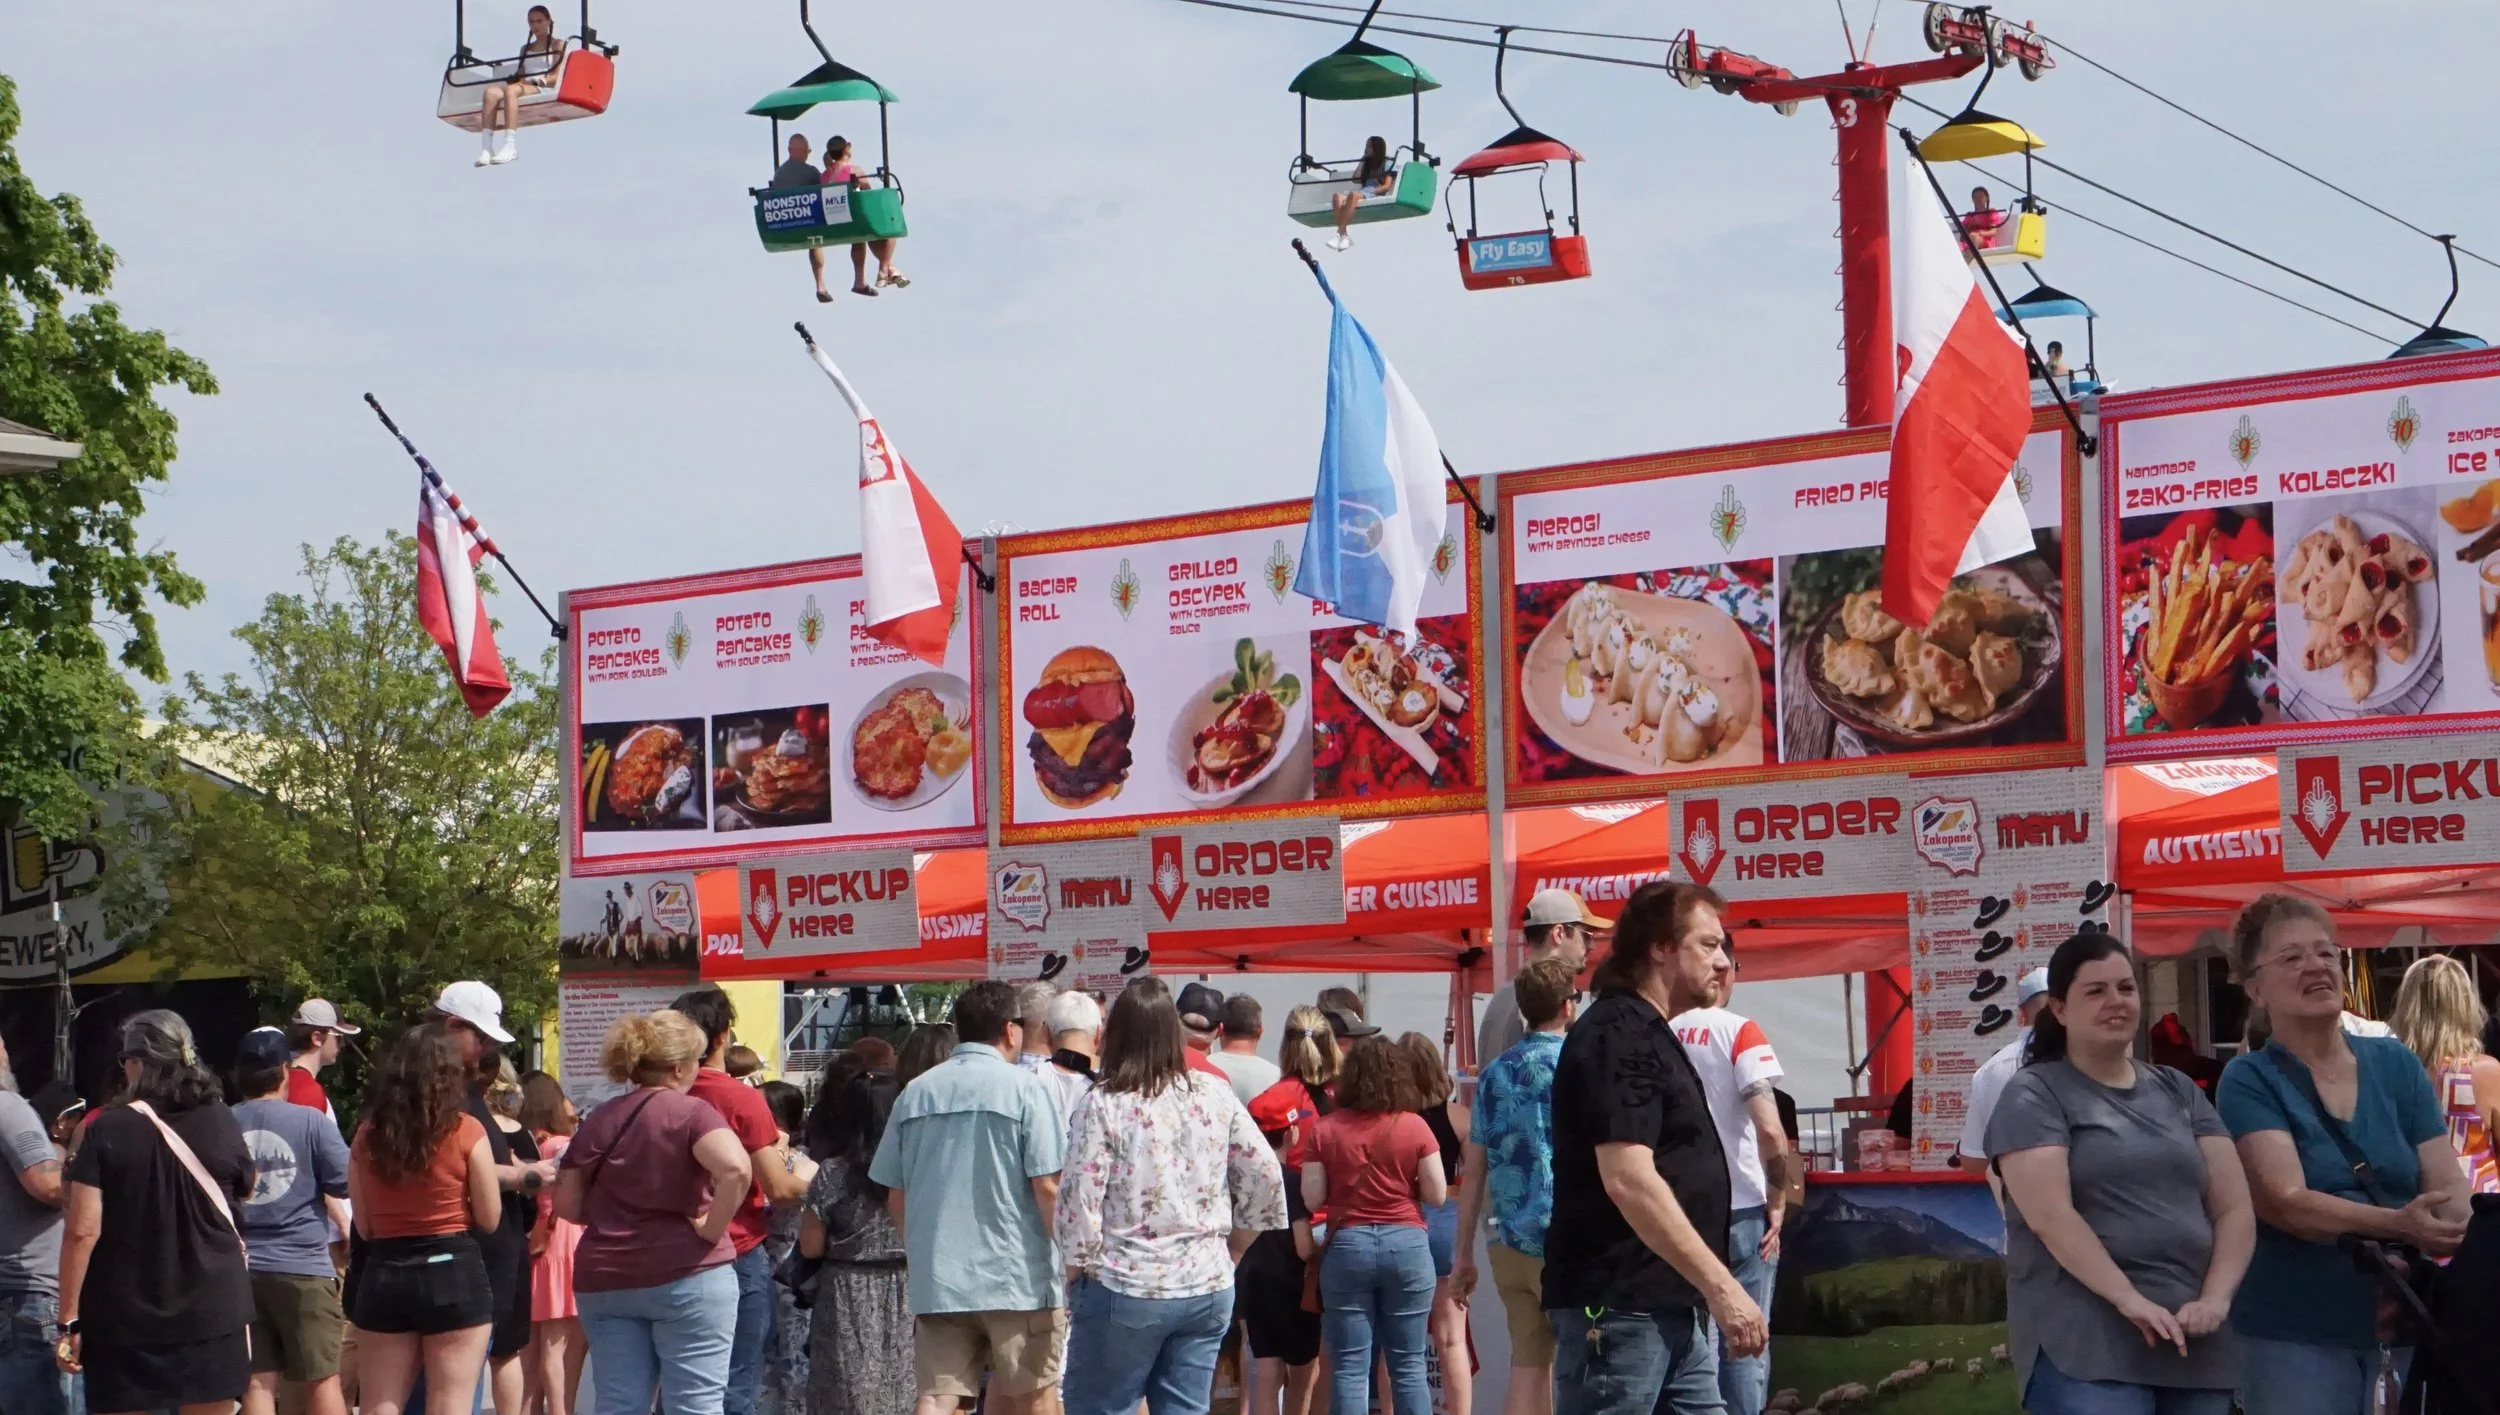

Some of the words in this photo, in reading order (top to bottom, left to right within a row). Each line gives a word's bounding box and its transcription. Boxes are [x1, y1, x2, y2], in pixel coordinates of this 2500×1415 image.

[1840, 98, 1858, 128] 3
[763, 193, 818, 211] NONSTOP
[764, 206, 812, 223] BOSTON
[807, 235, 824, 245] 77
[1480, 243, 1504, 261] Fly
[1507, 240, 1545, 257] Easy
[1507, 276, 1525, 285] 76
[2393, 419, 2414, 443] 10
[2237, 440, 2253, 460] 9
[2126, 460, 2196, 479] HANDMADE
[2448, 451, 2487, 474] ICE
[2279, 462, 2395, 494] KOLACZKI
[1795, 483, 1854, 508] FRIED
[2126, 475, 2258, 509] ZAKO-FRIES
[1527, 513, 1600, 537] PIEROGI
[1723, 512, 1736, 541] 7
[1528, 541, 1553, 552] WITH
[1556, 536, 1604, 550] BRYNDZA
[1608, 531, 1651, 545] CHEESE
[1169, 557, 1238, 581] GRILLED
[1436, 545, 1449, 572] 6
[1019, 577, 1077, 597] BACIAR
[1275, 565, 1287, 592] 5
[1120, 583, 1130, 611] 4
[1169, 581, 1246, 606] OSCYPEK
[716, 612, 772, 632] POTATO
[1020, 603, 1060, 622] ROLL
[1170, 610, 1192, 620] WITH
[1195, 603, 1251, 618] CRANBERRY
[588, 628, 641, 647] POTATO
[806, 618, 816, 643] 2
[1170, 623, 1200, 635] SAUCE
[716, 633, 791, 656] PANCAKES
[851, 643, 871, 653] WITH
[588, 648, 660, 670] PANCAKES
[717, 659, 736, 669] WITH
[738, 656, 760, 666] SOUR
[762, 652, 790, 665] CREAM
[858, 655, 885, 666] PEACH
[589, 672, 606, 683] WITH
[608, 670, 629, 681] PORK
[632, 666, 667, 678] GOULASH
[1734, 795, 1901, 844] ORDER
[1997, 810, 2089, 849] MENU
[2360, 813, 2465, 846] HERE
[1923, 832, 1972, 847] Zakopane
[1195, 836, 1333, 877] ORDER
[1736, 850, 1824, 881] HERE
[787, 867, 909, 907] PICKUP
[1059, 876, 1132, 910] MENU
[1196, 885, 1270, 911] HERE
[1384, 877, 1478, 910] CUISINE
[1003, 893, 1041, 906] Zakopane
[789, 913, 854, 938] HERE
[703, 933, 743, 956] POL
